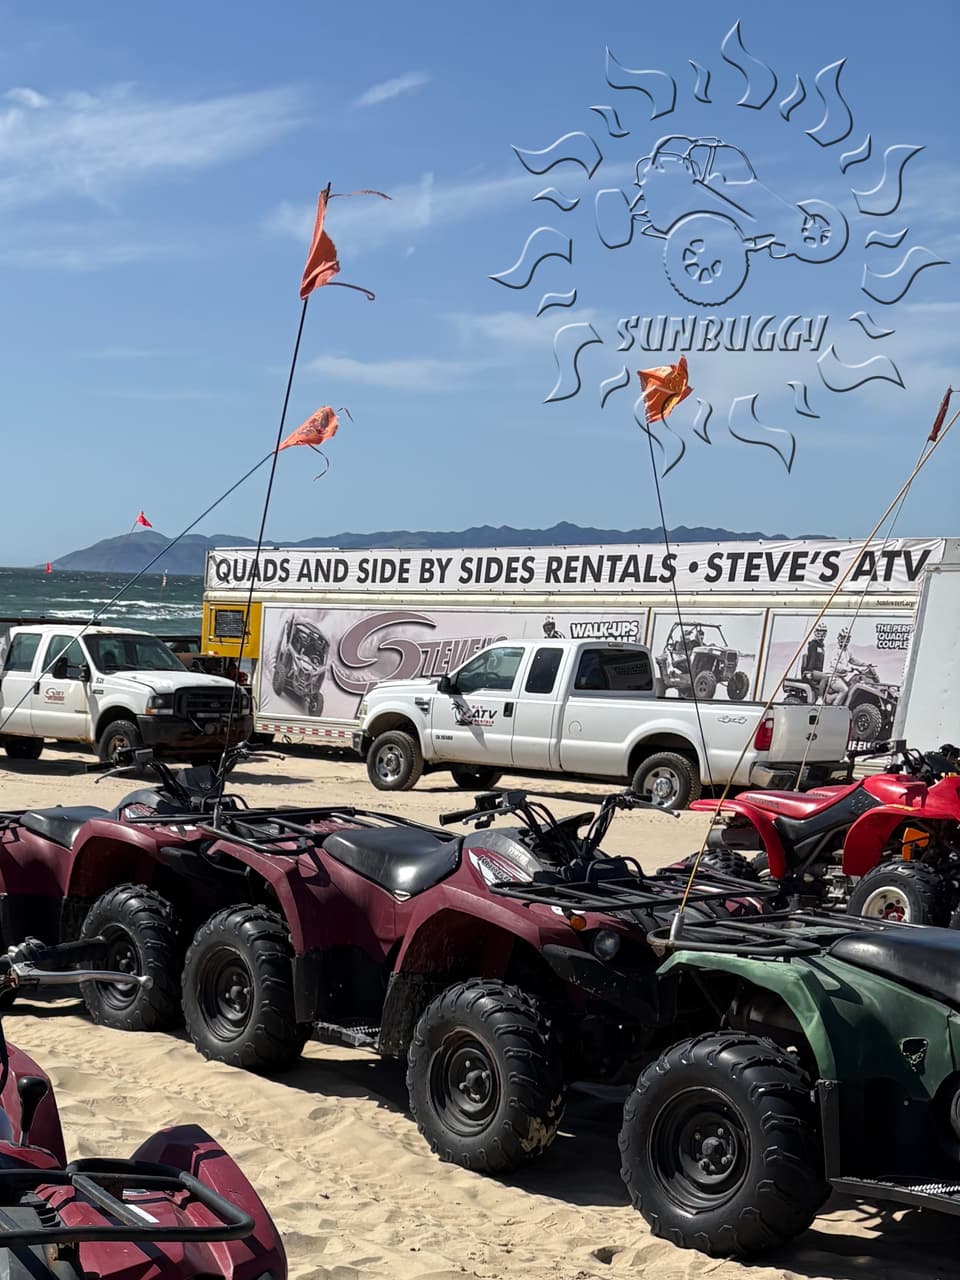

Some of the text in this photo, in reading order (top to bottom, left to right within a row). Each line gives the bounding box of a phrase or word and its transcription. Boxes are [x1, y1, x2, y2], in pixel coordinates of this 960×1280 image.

[215, 549, 933, 584] QUADS AND SIDE BY SIDES RENTALS STEVE'S ATV
[570, 620, 640, 639] WALK-UPS
[472, 709, 497, 719] ATV
